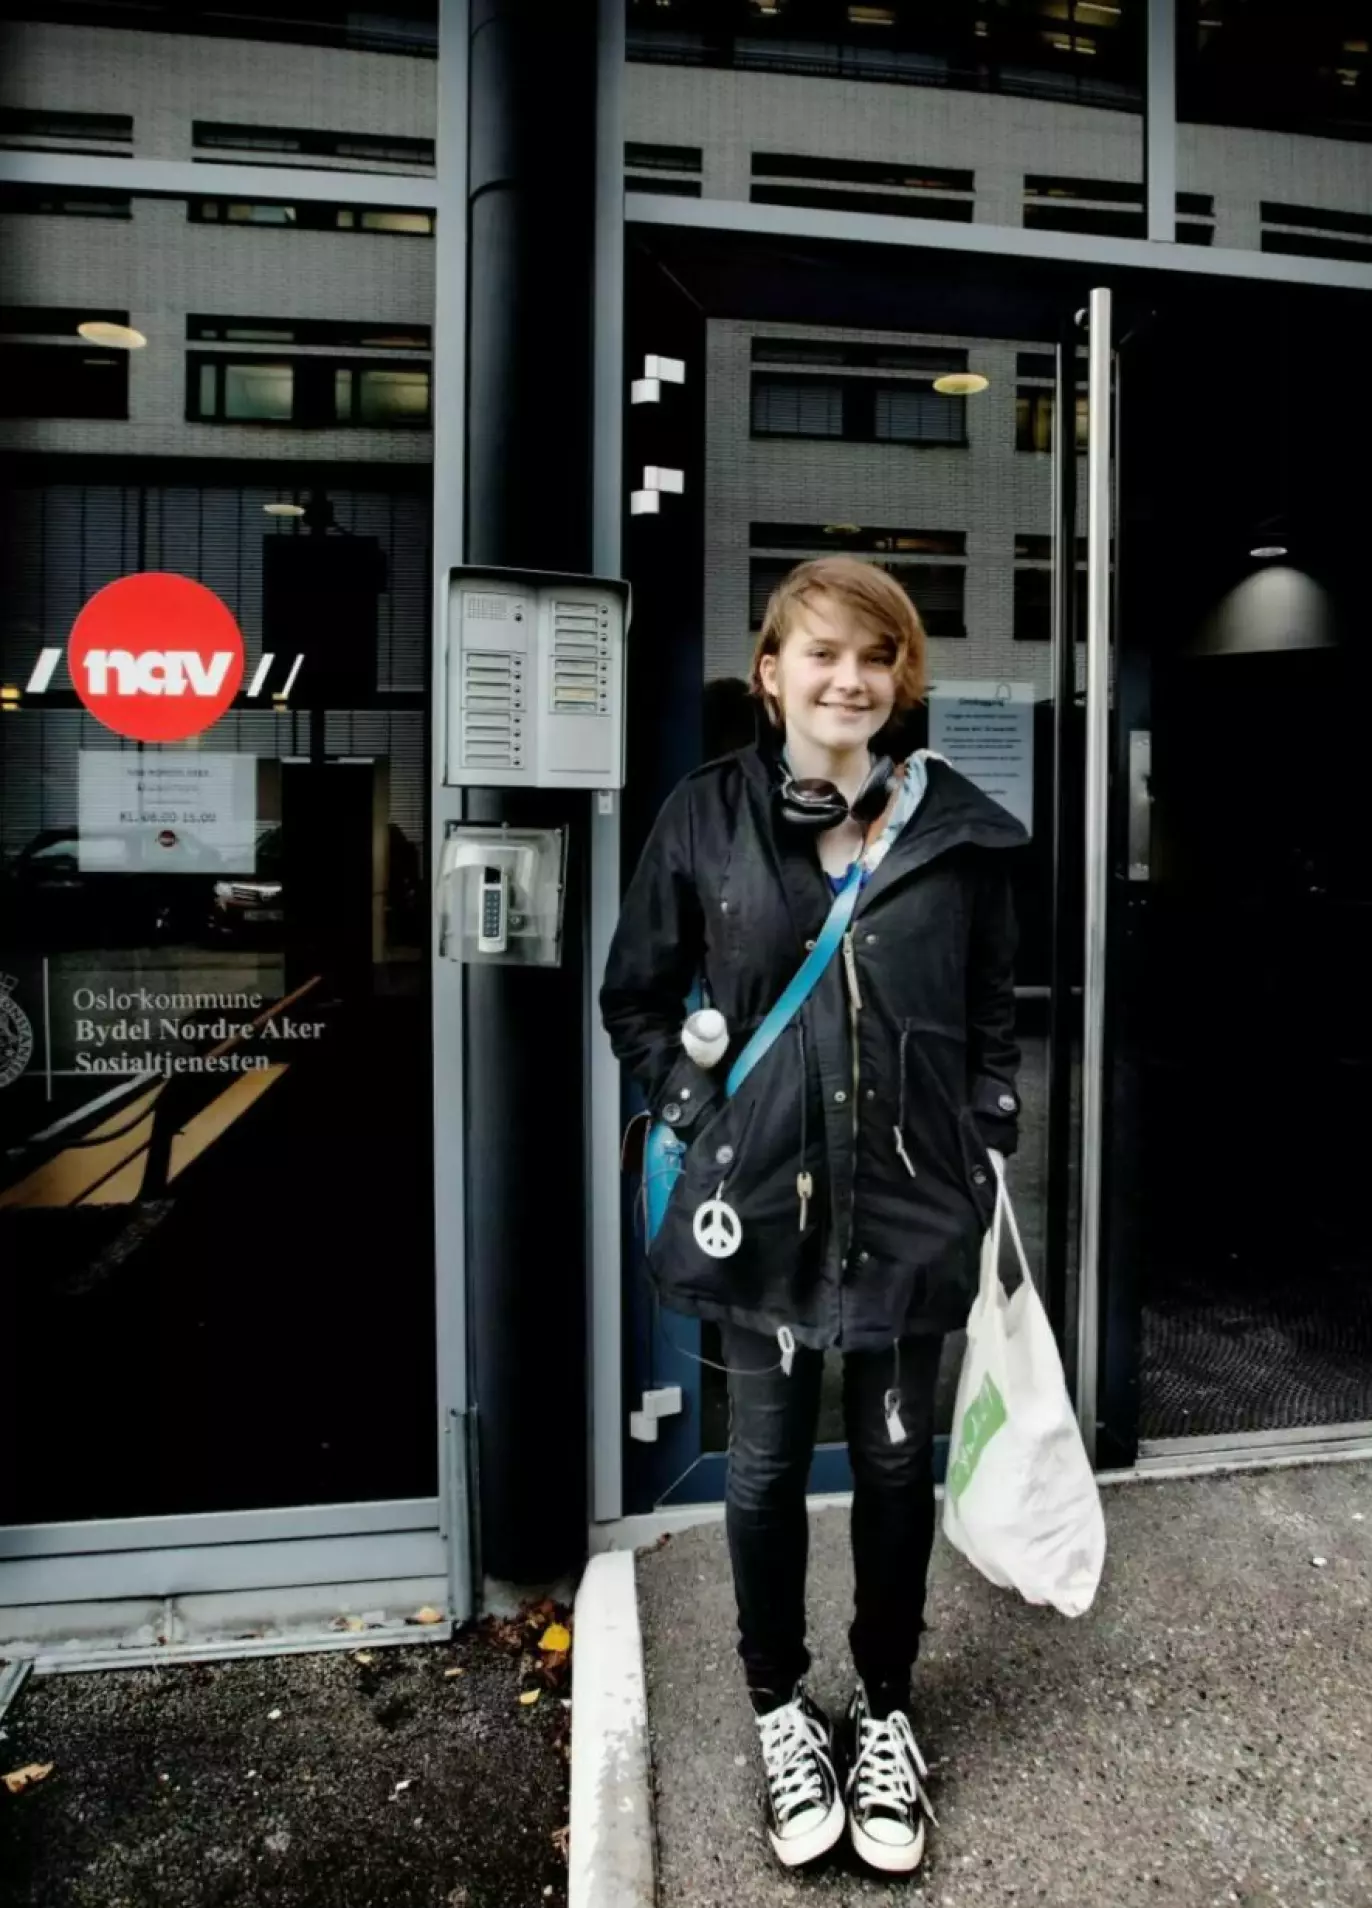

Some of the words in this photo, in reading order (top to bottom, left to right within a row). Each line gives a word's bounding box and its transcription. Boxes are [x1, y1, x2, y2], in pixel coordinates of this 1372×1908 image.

[73, 987, 132, 1011] Oslo
[139, 987, 263, 1010] kommune
[75, 1018, 151, 1046] Bydel
[159, 1017, 255, 1041] Nordre
[260, 1016, 326, 1040] Aker
[75, 1051, 270, 1078] Sosialtjenesten
